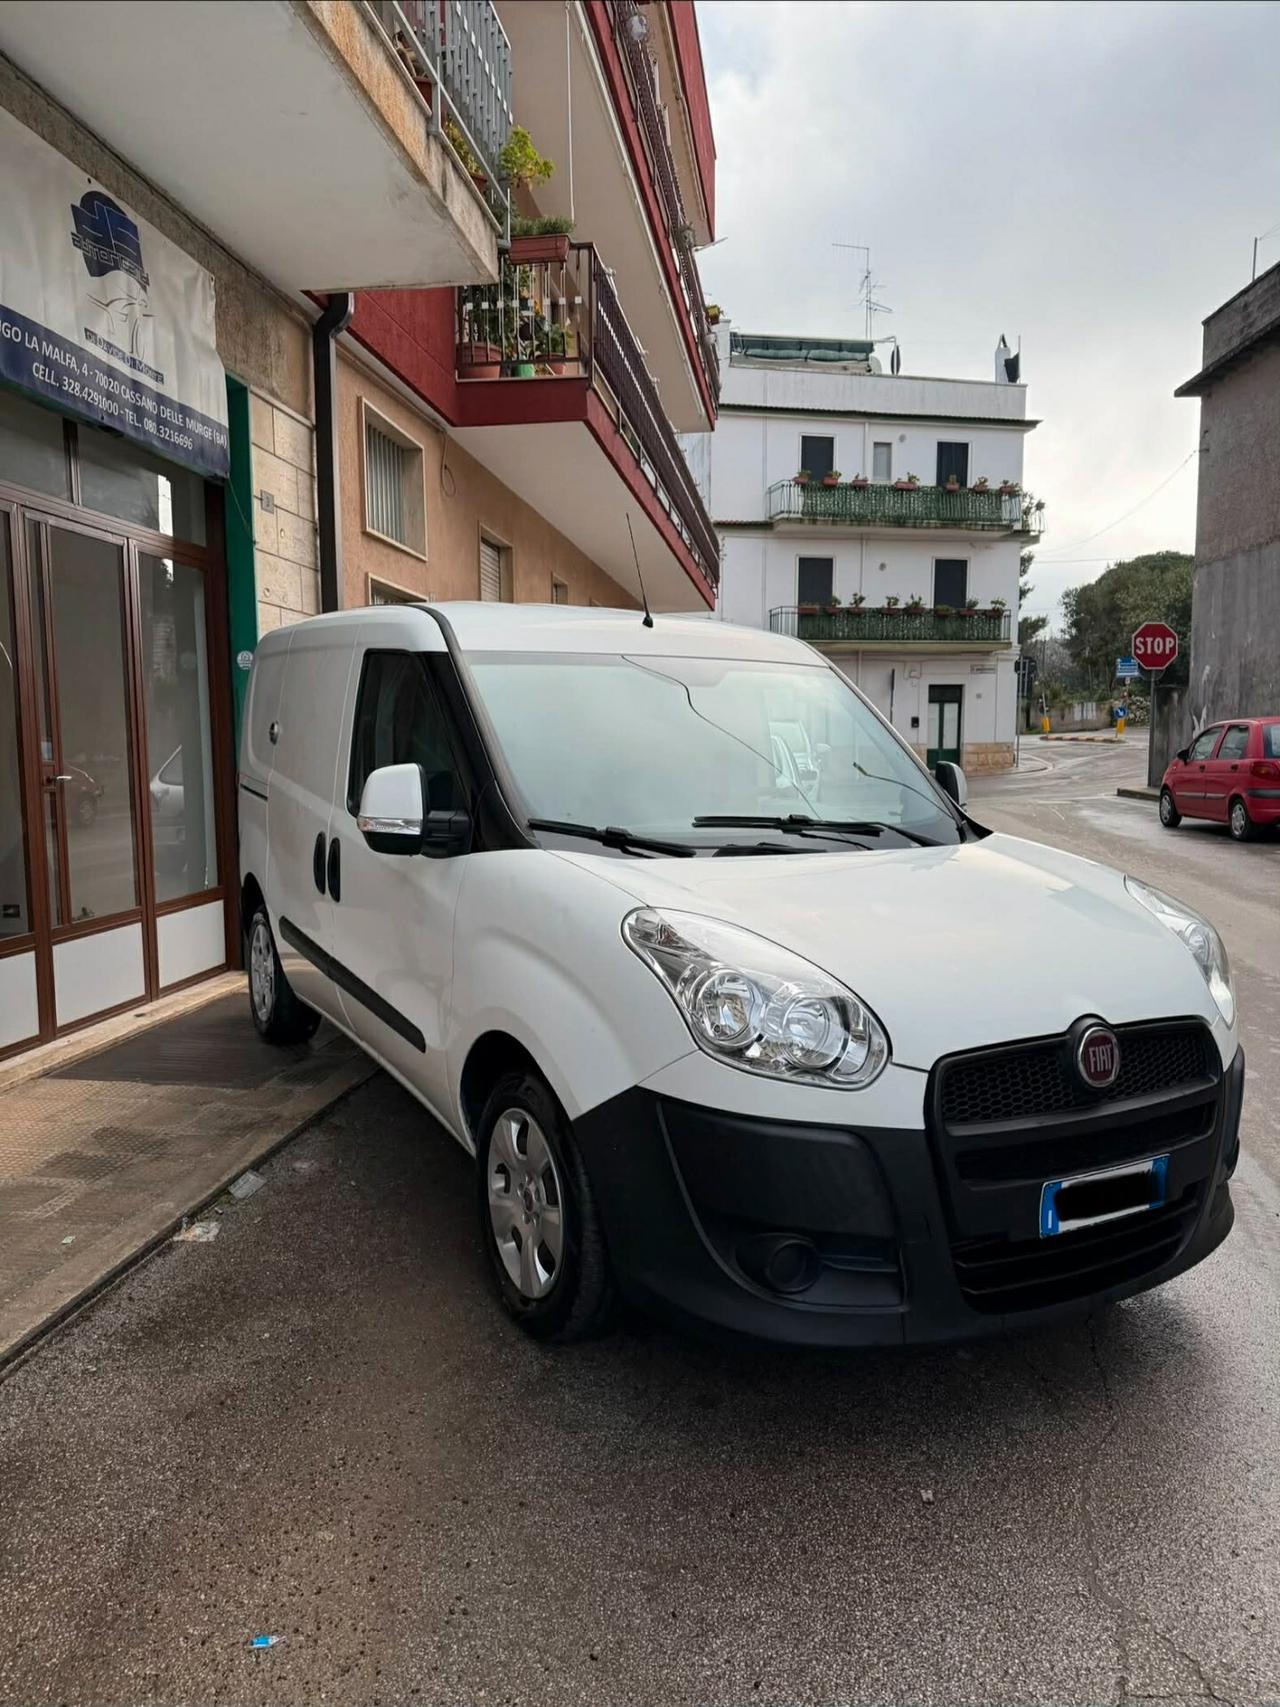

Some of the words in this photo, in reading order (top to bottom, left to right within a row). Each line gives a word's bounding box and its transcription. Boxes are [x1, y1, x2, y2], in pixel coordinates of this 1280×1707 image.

[0, 320, 21, 343] GO
[25, 332, 39, 352] LA
[42, 341, 80, 375] MALFA,
[82, 363, 88, 376] 4
[95, 369, 120, 394] 70020
[121, 385, 158, 414] CASSANO
[160, 405, 184, 427] DELLE
[186, 417, 212, 440] MURGE
[213, 429, 227, 449] (BA)
[33, 362, 59, 387] CELL.
[62, 376, 119, 415] 328.4291000
[144, 418, 193, 450] 080.3216696
[1135, 637, 1174, 654] STOP
[1089, 1043, 1111, 1073] FIAT
